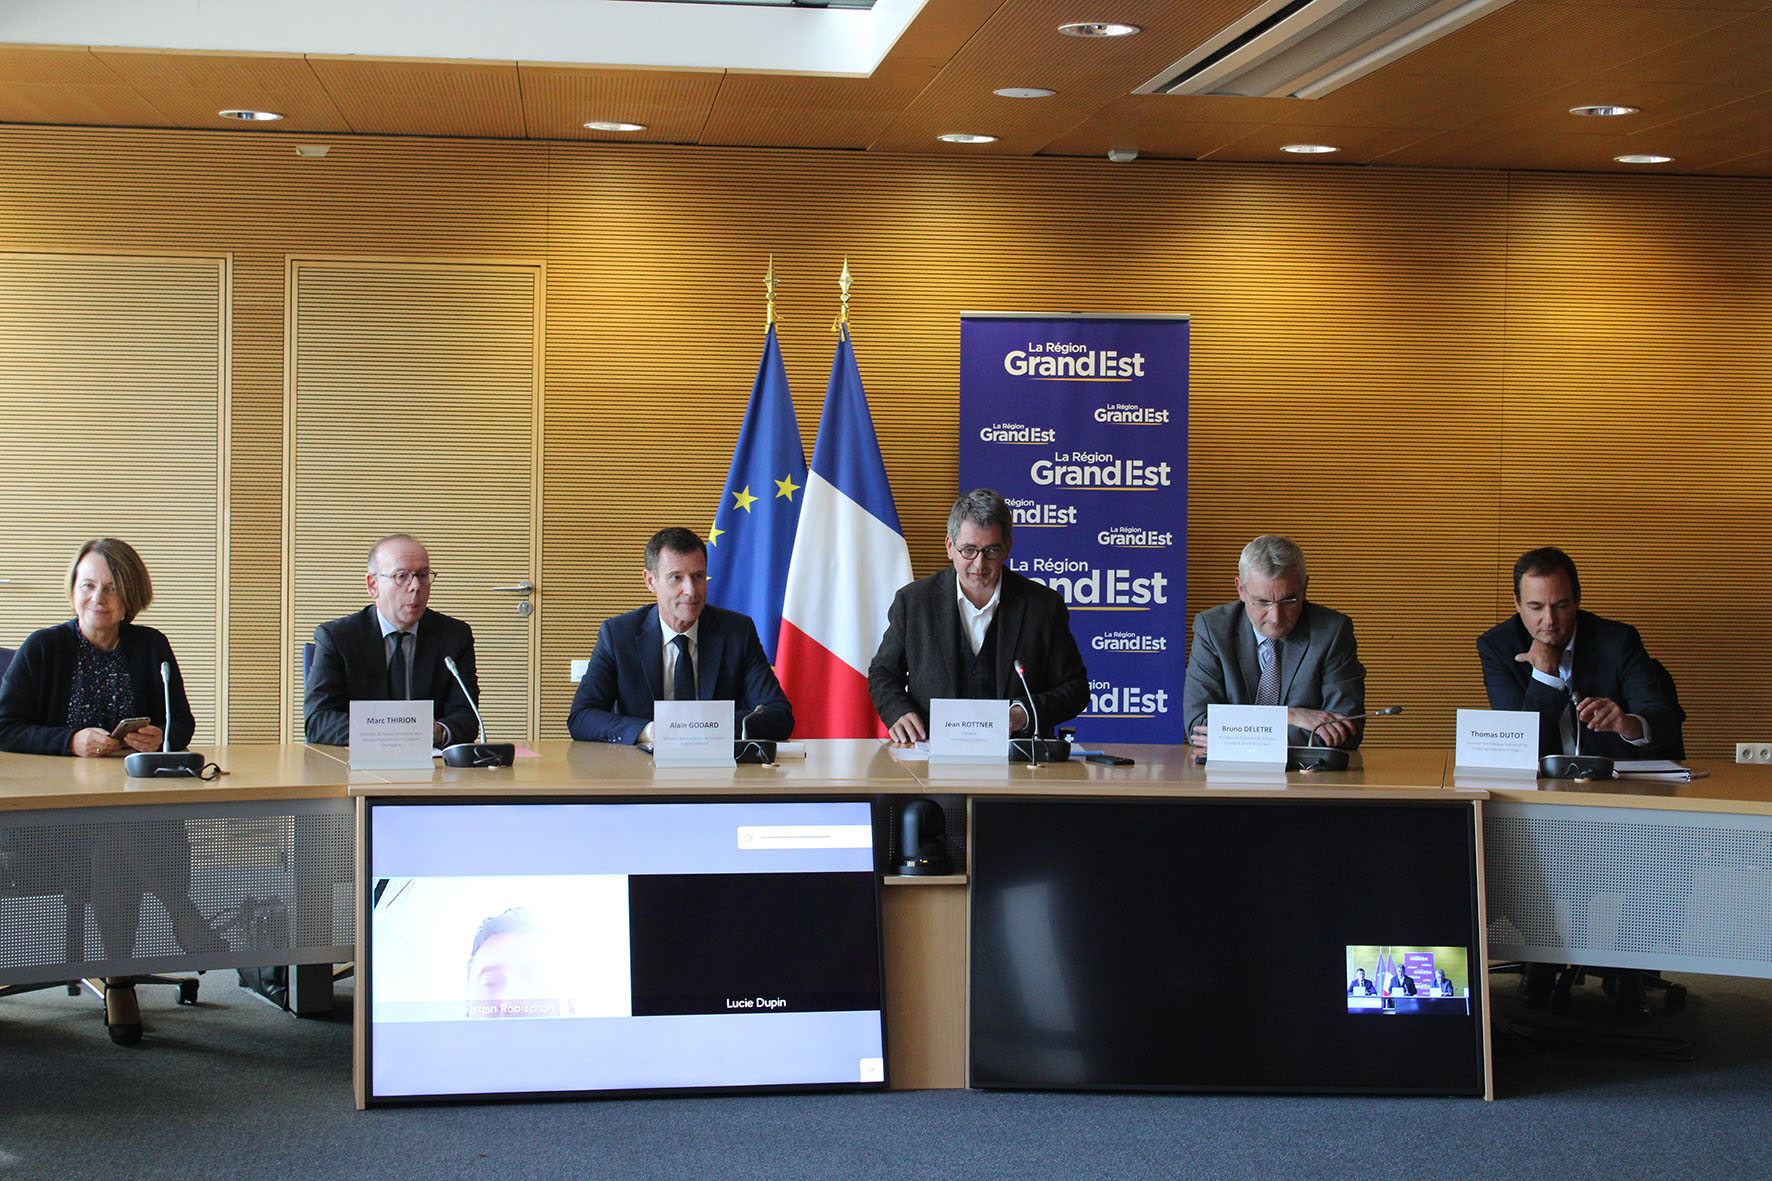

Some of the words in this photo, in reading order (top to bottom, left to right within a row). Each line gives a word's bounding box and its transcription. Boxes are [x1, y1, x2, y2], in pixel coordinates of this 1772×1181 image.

[1028, 342, 1043, 353] La
[1046, 342, 1087, 354] Région
[1116, 403, 1139, 411] Région
[1055, 451, 1069, 462] La
[1072, 451, 1113, 464] Région
[1119, 526, 1142, 534] Région
[1009, 558, 1029, 572] La
[1033, 558, 1089, 574] Région
[1113, 631, 1136, 639] Région
[366, 717, 385, 725] Marc
[386, 716, 417, 724] THIRION
[688, 721, 720, 729] GODARD
[961, 721, 994, 729] ROTTNER
[1221, 725, 1243, 733] Bruno
[1243, 725, 1273, 734] DELETRE
[1470, 730, 1498, 739] Thomas
[1499, 731, 1524, 740] DUTOT
[726, 998, 754, 1009] Lucie
[756, 997, 787, 1010] Dupin
